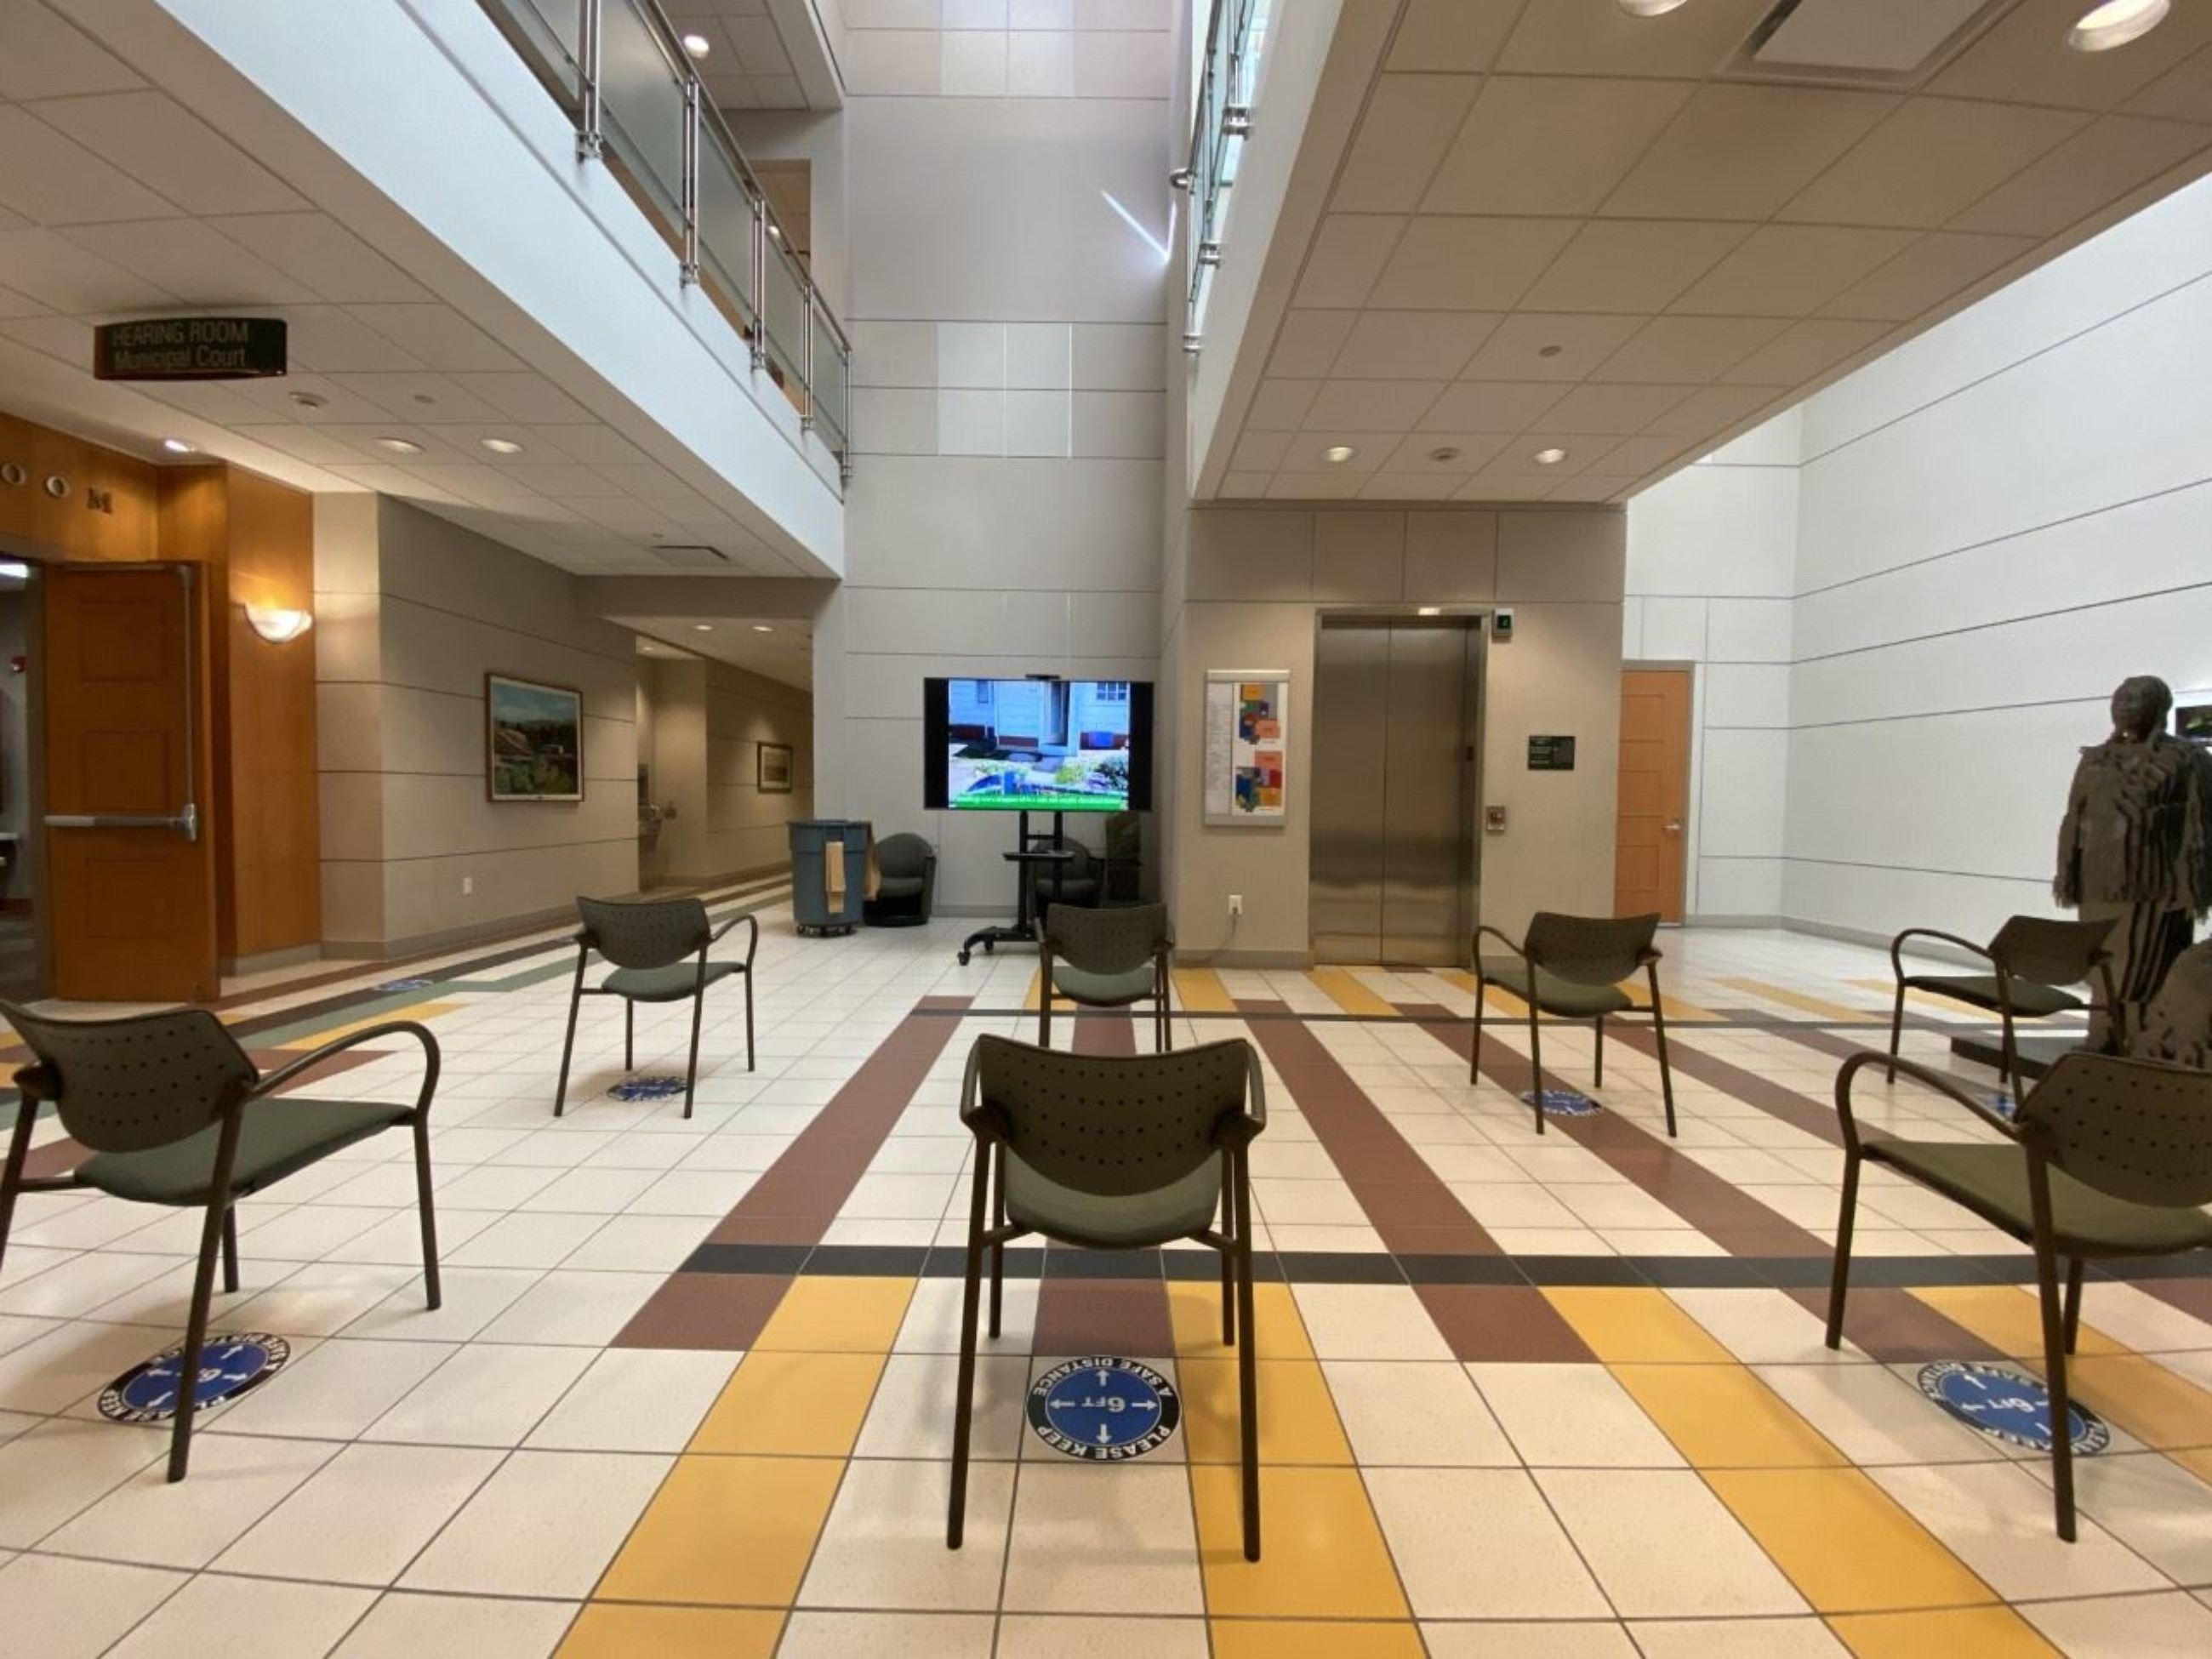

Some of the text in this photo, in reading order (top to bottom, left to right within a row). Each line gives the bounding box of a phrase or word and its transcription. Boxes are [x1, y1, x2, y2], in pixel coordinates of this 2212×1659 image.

[112, 321, 249, 346] HEARING ROOM
[114, 345, 247, 372] Municipal Court
[1032, 1357, 1174, 1397] A SAFE DISTANCE
[1036, 1424, 1172, 1460] PLEASE KEEP
